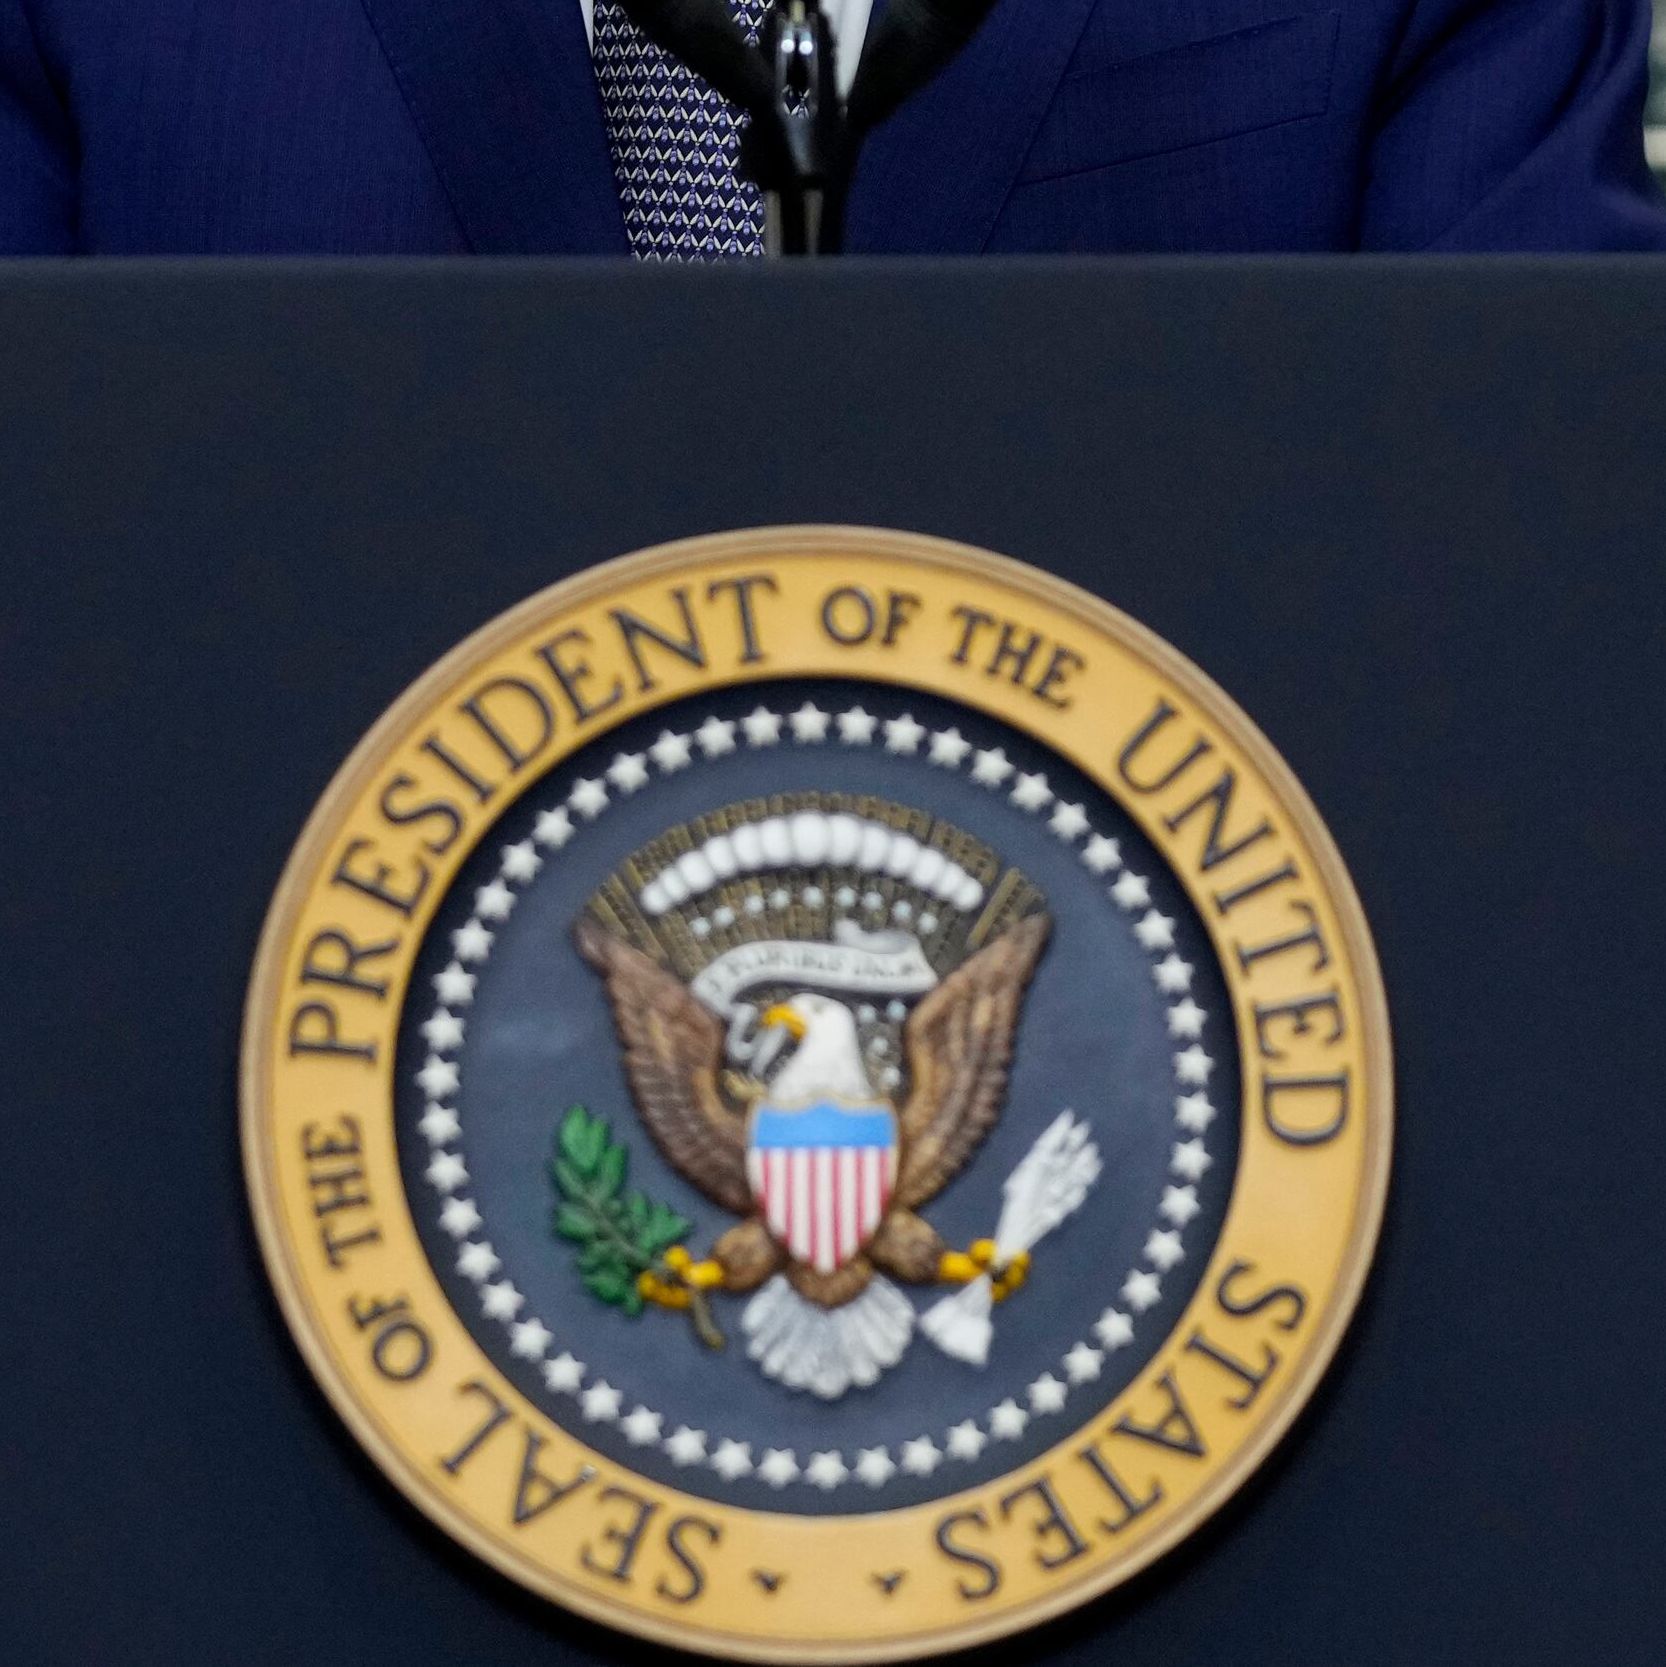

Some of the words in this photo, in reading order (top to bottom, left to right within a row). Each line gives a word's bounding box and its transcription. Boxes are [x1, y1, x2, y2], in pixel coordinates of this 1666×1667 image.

[820, 586, 921, 648] OF
[951, 605, 1084, 710] THE
[287, 575, 778, 1065] PRESIDENT
[1116, 698, 1350, 1150] UNITED
[300, 1112, 383, 1269] THE
[347, 1294, 434, 1384] OF
[934, 1261, 1307, 1602] STATES
[441, 1382, 722, 1605] SEAL
